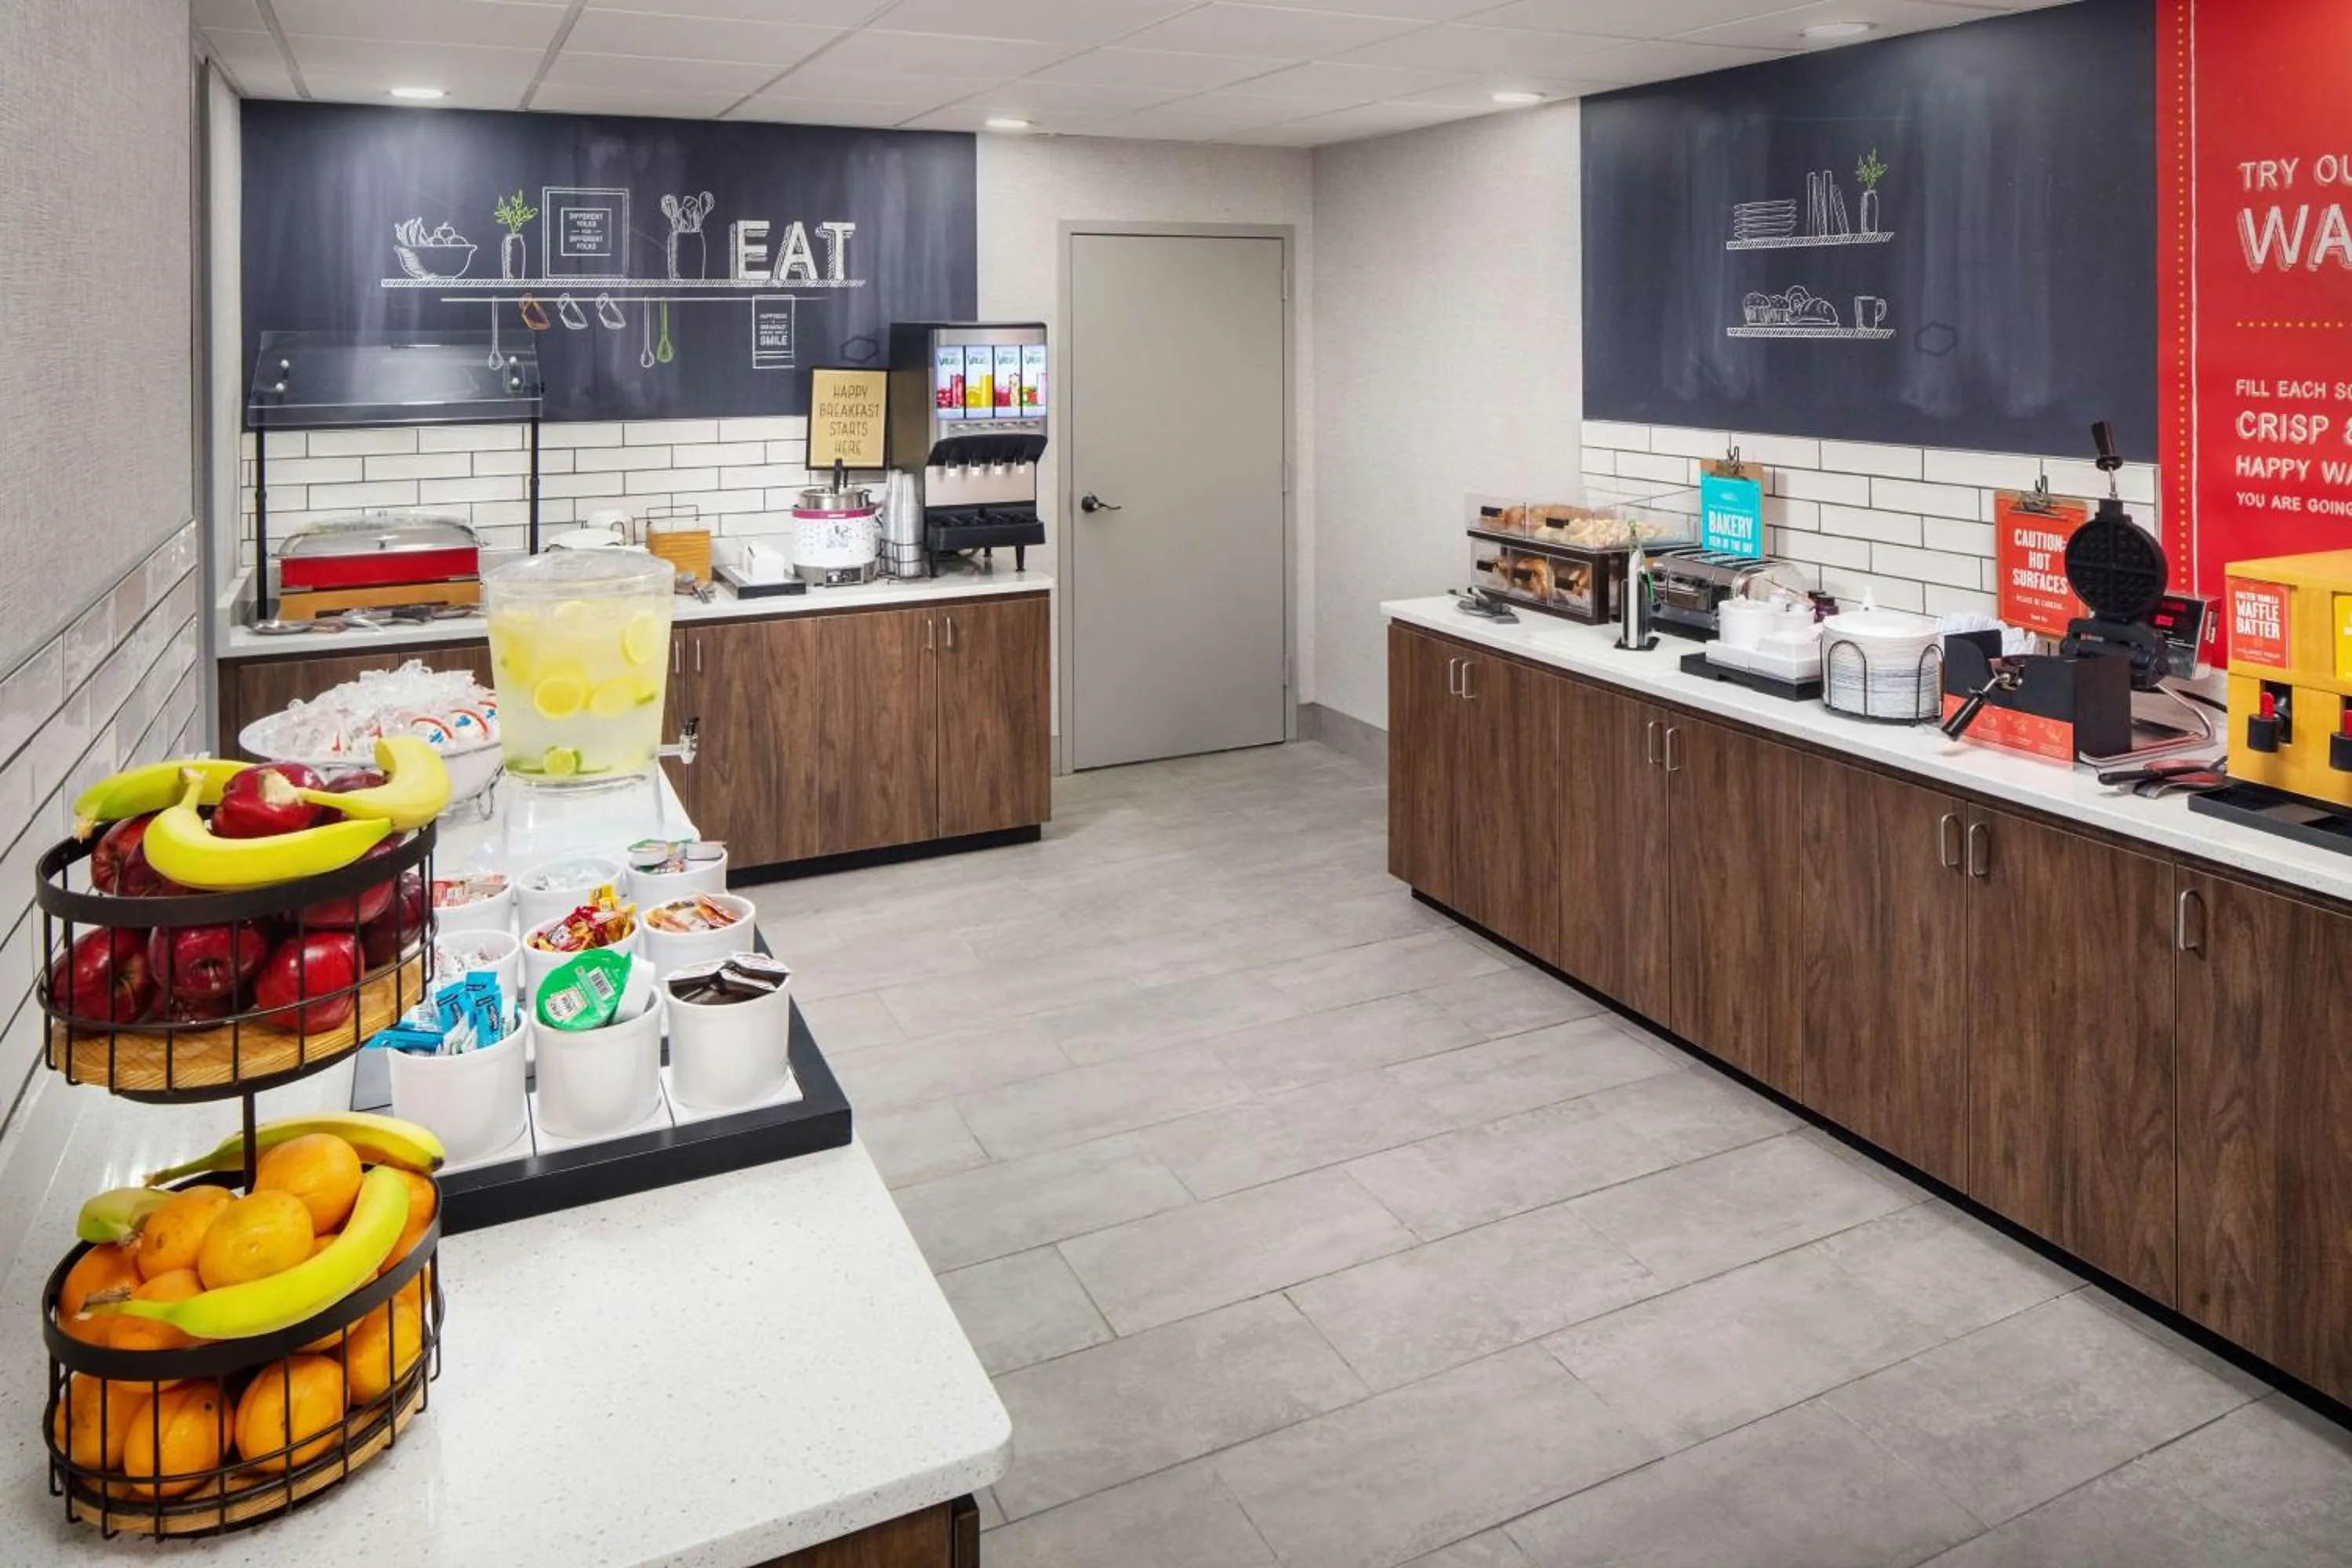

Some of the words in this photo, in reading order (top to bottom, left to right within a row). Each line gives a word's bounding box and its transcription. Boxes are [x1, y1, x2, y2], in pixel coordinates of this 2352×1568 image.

[2238, 158, 2299, 191] TRY
[2237, 204, 2352, 273] WA
[730, 220, 855, 282] EAT
[760, 335, 788, 346] SMILE
[833, 384, 869, 398] HAPPY
[2236, 379, 2270, 397] FILL
[2277, 380, 2326, 399] EACH
[819, 403, 879, 418] BREAKFAST
[829, 422, 868, 436] STARTS
[2236, 410, 2329, 445] CRISP
[834, 440, 862, 455] HERE
[2235, 455, 2310, 482] HAPPY
[2236, 491, 2265, 508] YOU
[2271, 495, 2301, 511] ARE
[1708, 510, 1753, 539] BAKERY
[2014, 528, 2067, 552] CAUTION:
[2029, 550, 2051, 571] HOT
[2013, 568, 2068, 595] SURFACES
[2237, 599, 2280, 622] WAFFLE
[2236, 617, 2281, 640] BATTER
